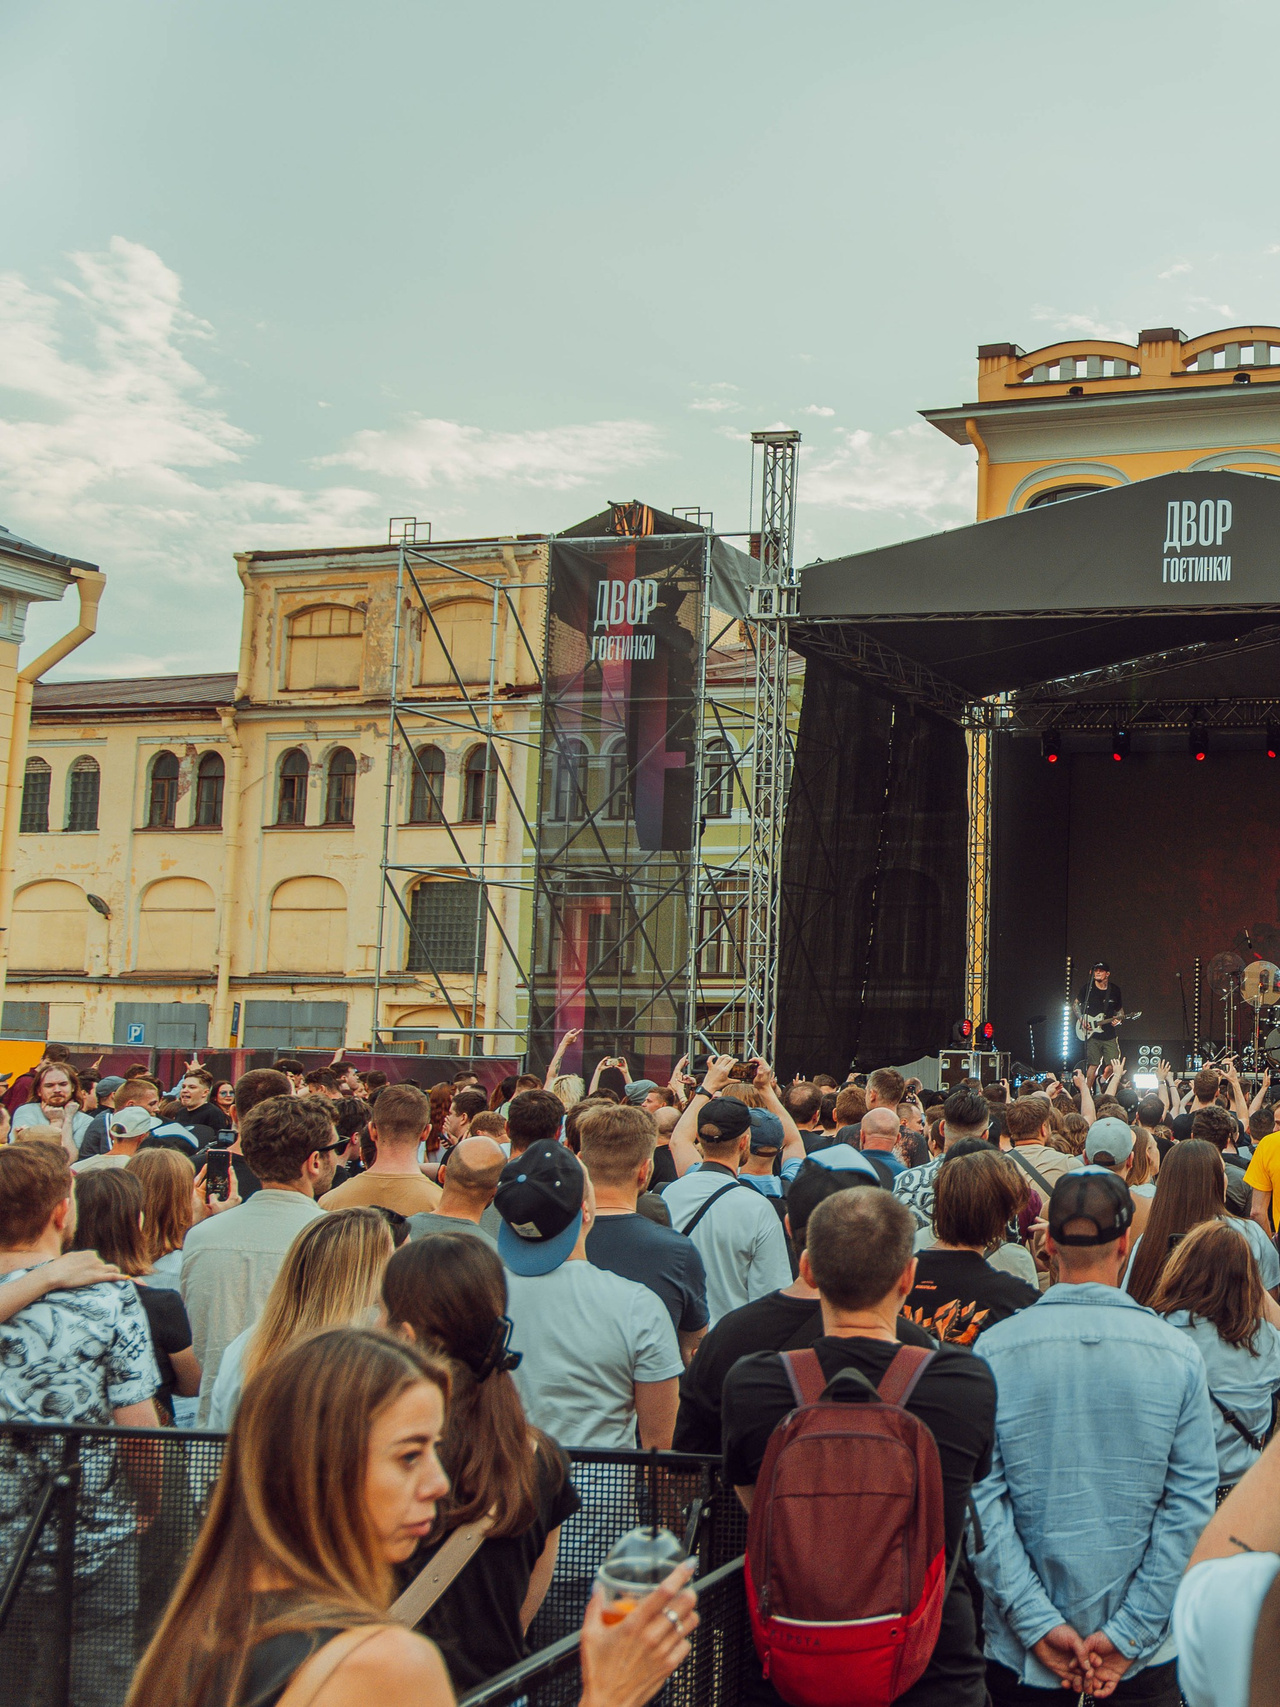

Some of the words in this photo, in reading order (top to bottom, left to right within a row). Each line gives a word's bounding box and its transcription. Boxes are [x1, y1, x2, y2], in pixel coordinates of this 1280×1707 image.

[1163, 499, 1232, 554] ДВОР
[1162, 556, 1231, 583] ГОСТИНКИ
[593, 579, 658, 632] ДВОР
[591, 635, 656, 660] ГОСТИНКИ
